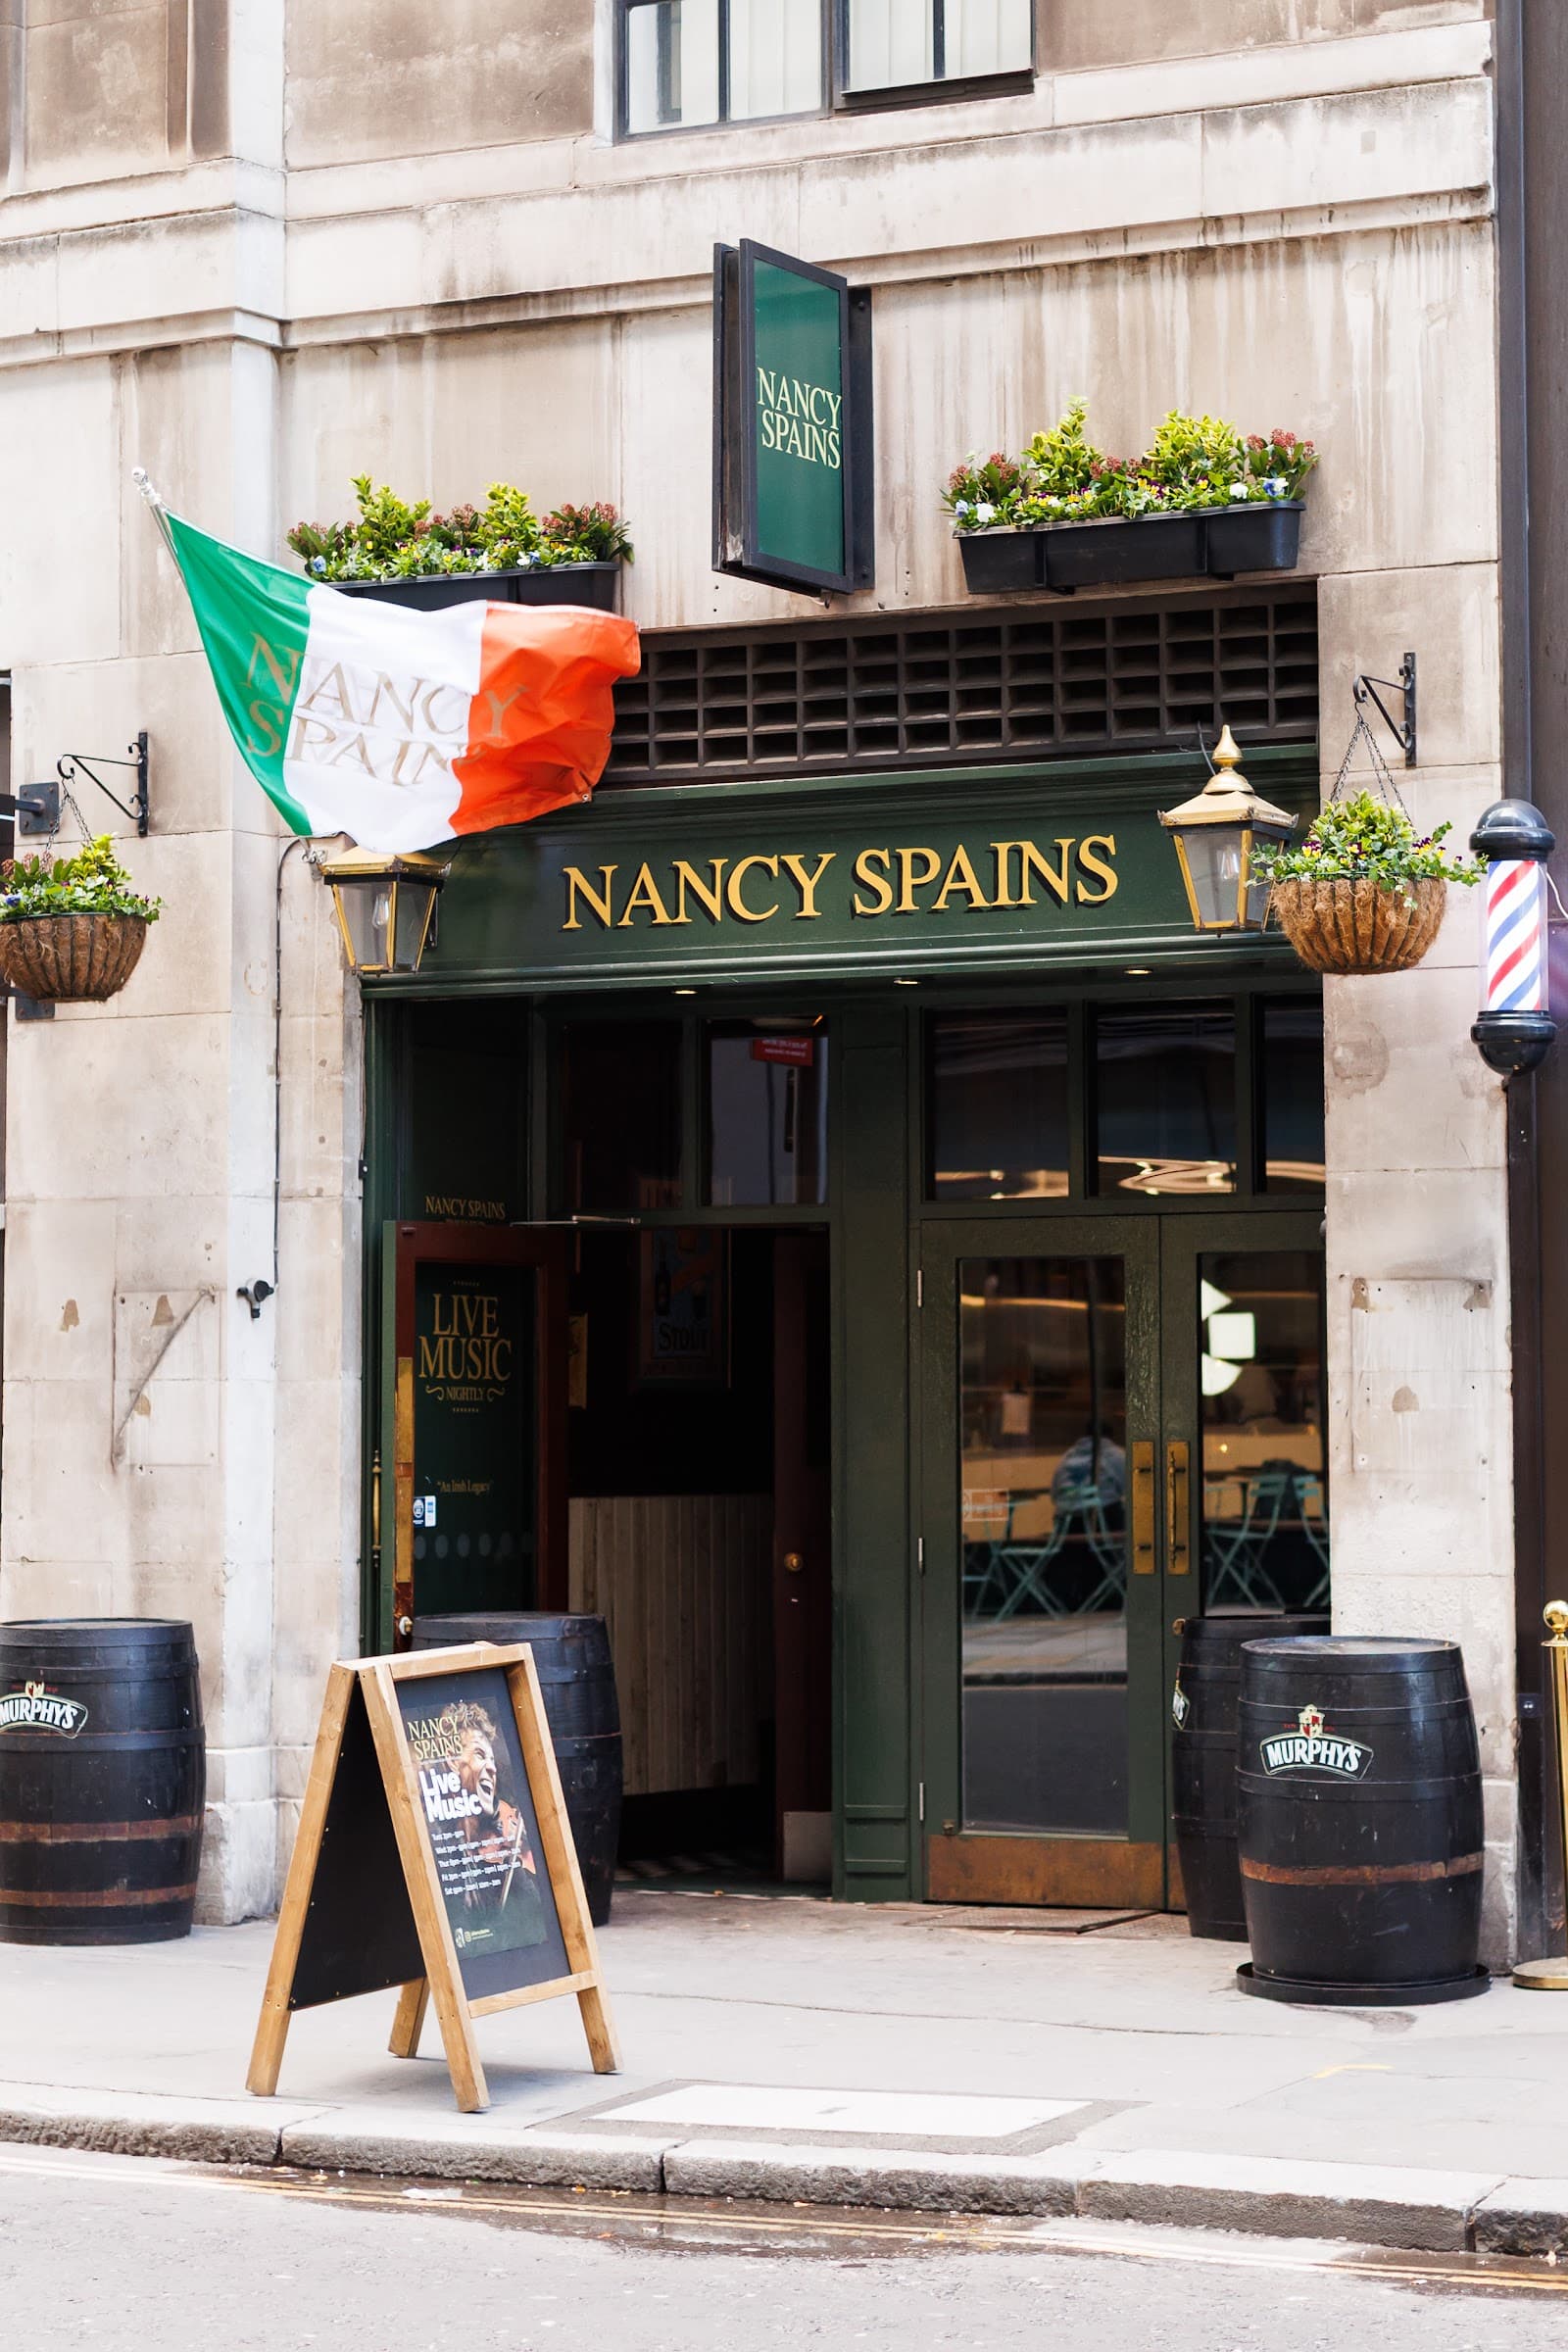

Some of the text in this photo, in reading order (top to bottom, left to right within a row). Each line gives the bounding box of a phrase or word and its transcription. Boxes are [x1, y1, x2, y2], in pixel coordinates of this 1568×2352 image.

[757, 367, 842, 431] NANCY
[761, 409, 841, 469] SPAINS
[241, 631, 529, 738] NANCY
[246, 699, 488, 787] SPAIN
[562, 833, 1119, 930] NANCY SPAINS
[425, 1196, 506, 1220] NANCY SPAINS
[432, 1293, 500, 1338] LIVE
[418, 1335, 513, 1381] MUSIC
[446, 1386, 487, 1402] NIGHTLY
[408, 1715, 460, 1741] NANCY
[414, 1735, 464, 1761] SPAINS
[418, 1768, 461, 1797] Live
[423, 1788, 482, 1823] Music
